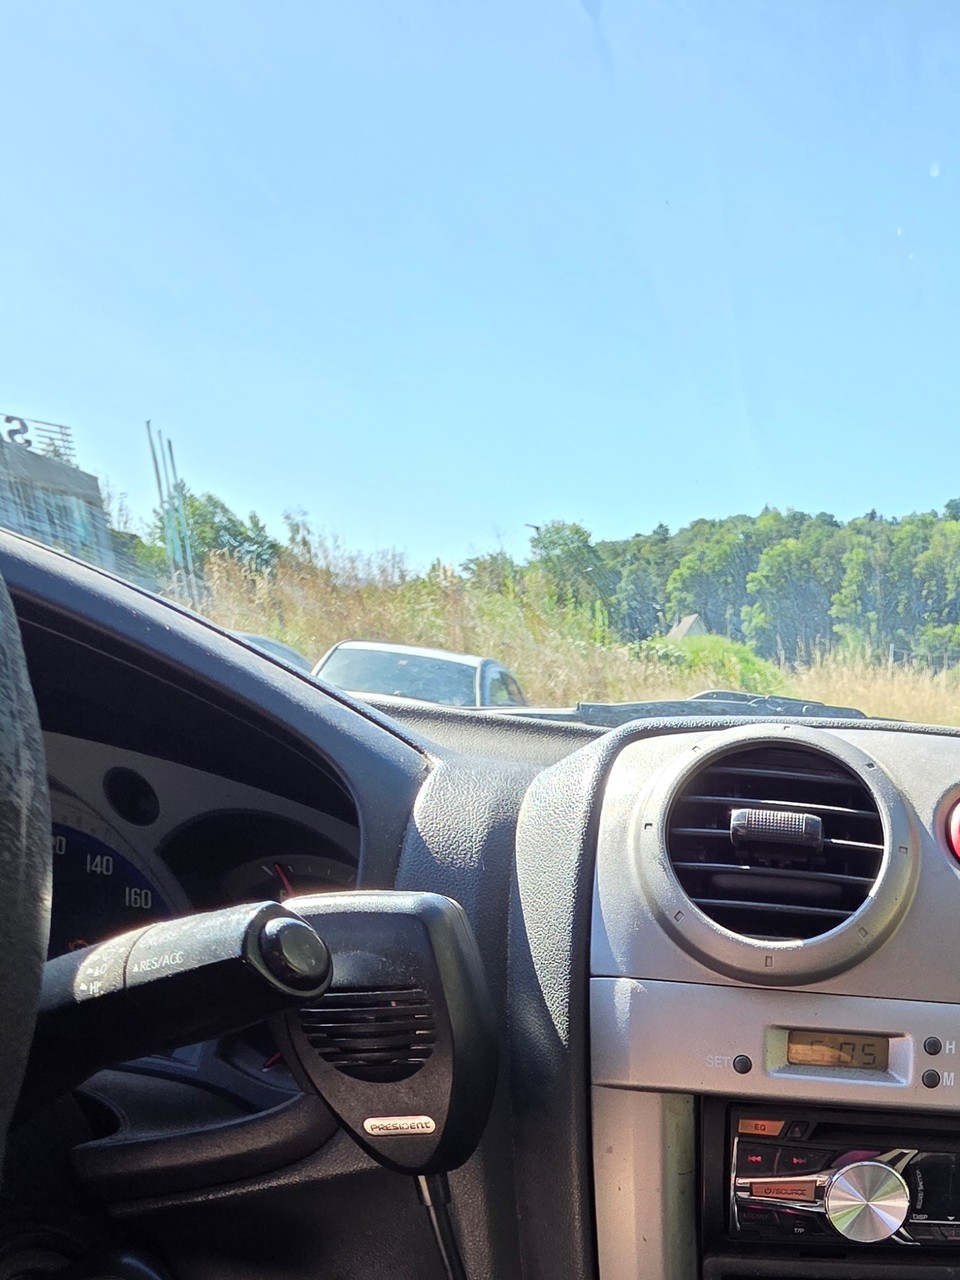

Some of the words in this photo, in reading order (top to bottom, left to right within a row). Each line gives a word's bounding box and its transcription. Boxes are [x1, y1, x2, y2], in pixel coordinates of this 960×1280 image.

[86, 853, 114, 876] 140
[125, 886, 152, 909] 160
[140, 951, 184, 972] RES/ACC
[945, 1041, 956, 1054] H
[705, 1055, 729, 1069] SET
[943, 1072, 955, 1086] M
[370, 1121, 431, 1132] PRESIDENT
[754, 1123, 767, 1132] EQ
